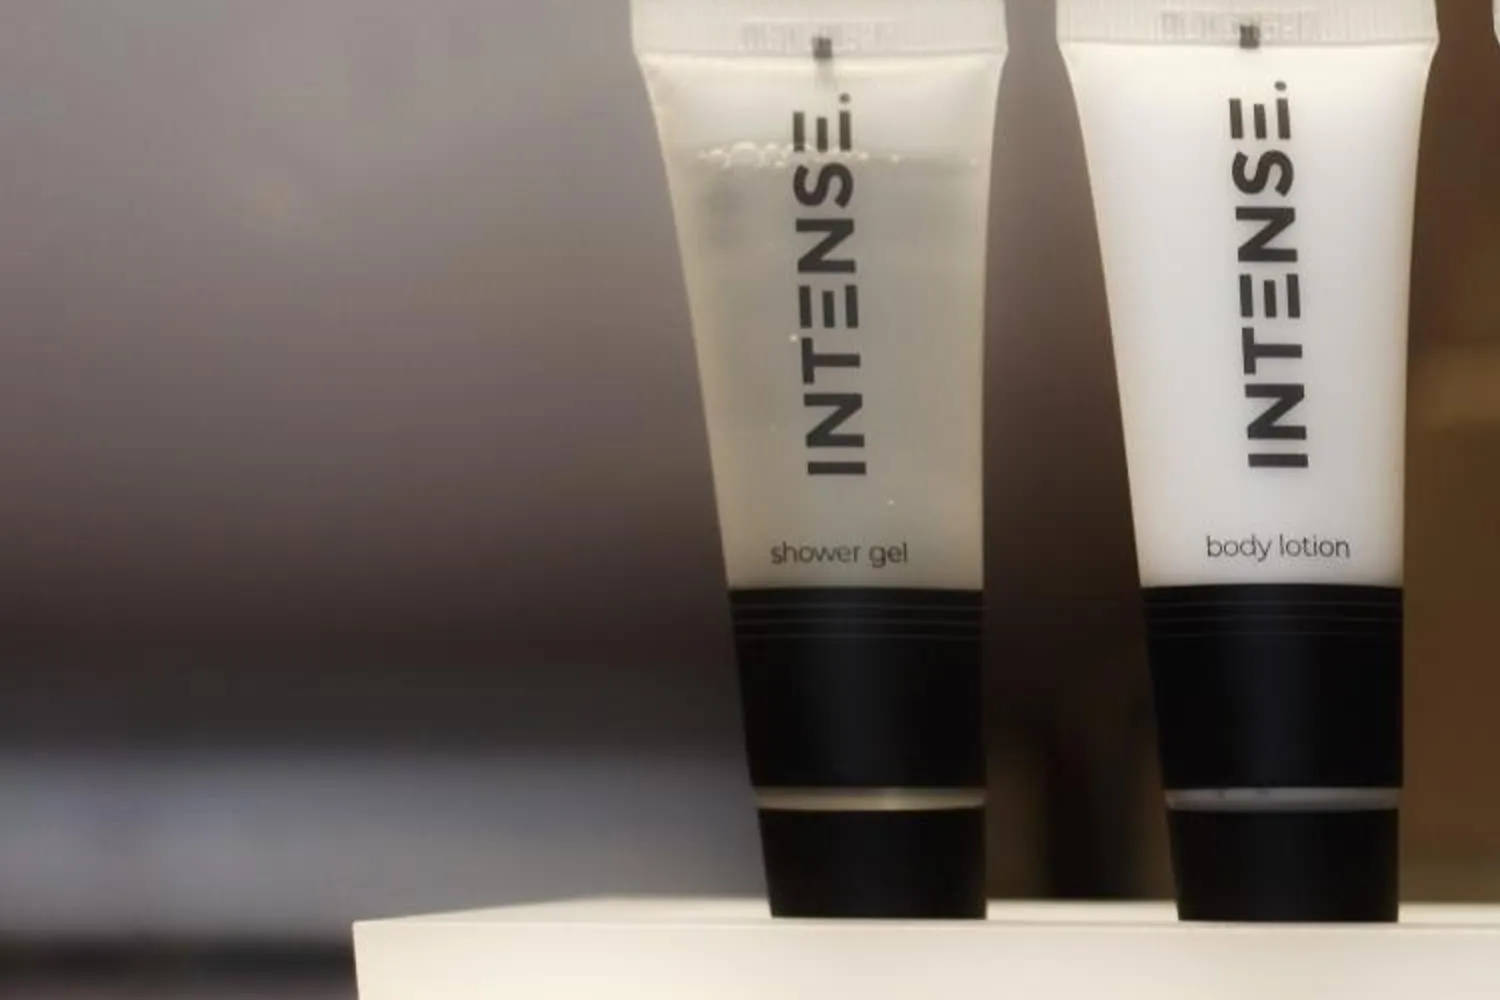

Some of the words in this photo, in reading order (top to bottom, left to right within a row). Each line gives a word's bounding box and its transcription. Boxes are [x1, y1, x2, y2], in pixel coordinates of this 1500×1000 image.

[792, 92, 867, 476] INTENSE.
[1229, 80, 1309, 469] INTENSE.
[770, 541, 861, 566] shower
[869, 542, 908, 569] gel
[1206, 534, 1272, 562] body
[1279, 533, 1351, 560] lotion
